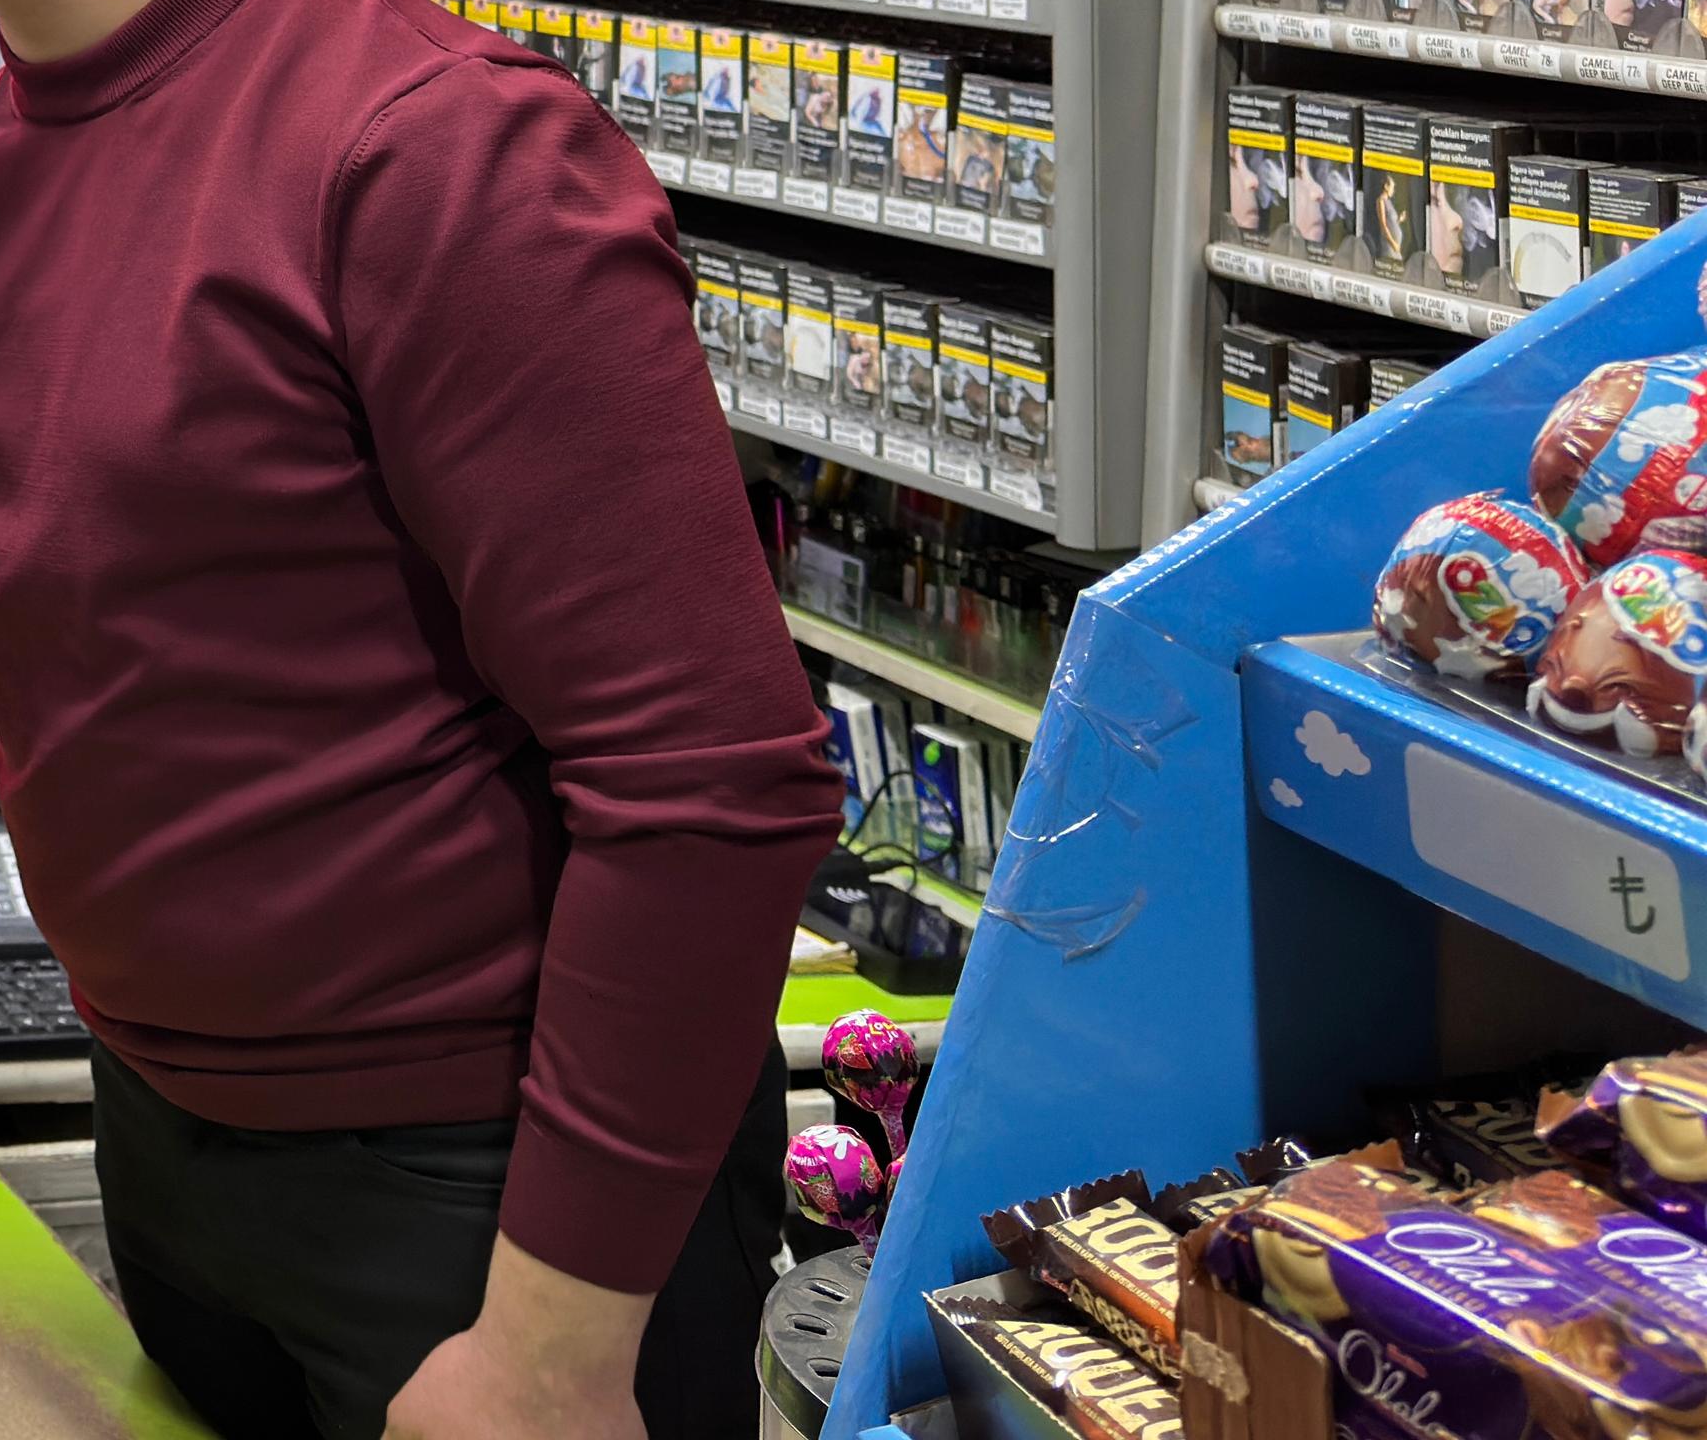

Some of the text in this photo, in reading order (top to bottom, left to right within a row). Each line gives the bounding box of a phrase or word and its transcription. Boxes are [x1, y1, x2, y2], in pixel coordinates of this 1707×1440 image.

[1352, 28, 1380, 41] CAMEL
[1425, 37, 1453, 50] CAMEL
[1500, 43, 1530, 58] CAMEL
[1503, 55, 1528, 68] WHITE
[1581, 57, 1615, 71] CAMEL
[1666, 68, 1700, 83] CAMEL
